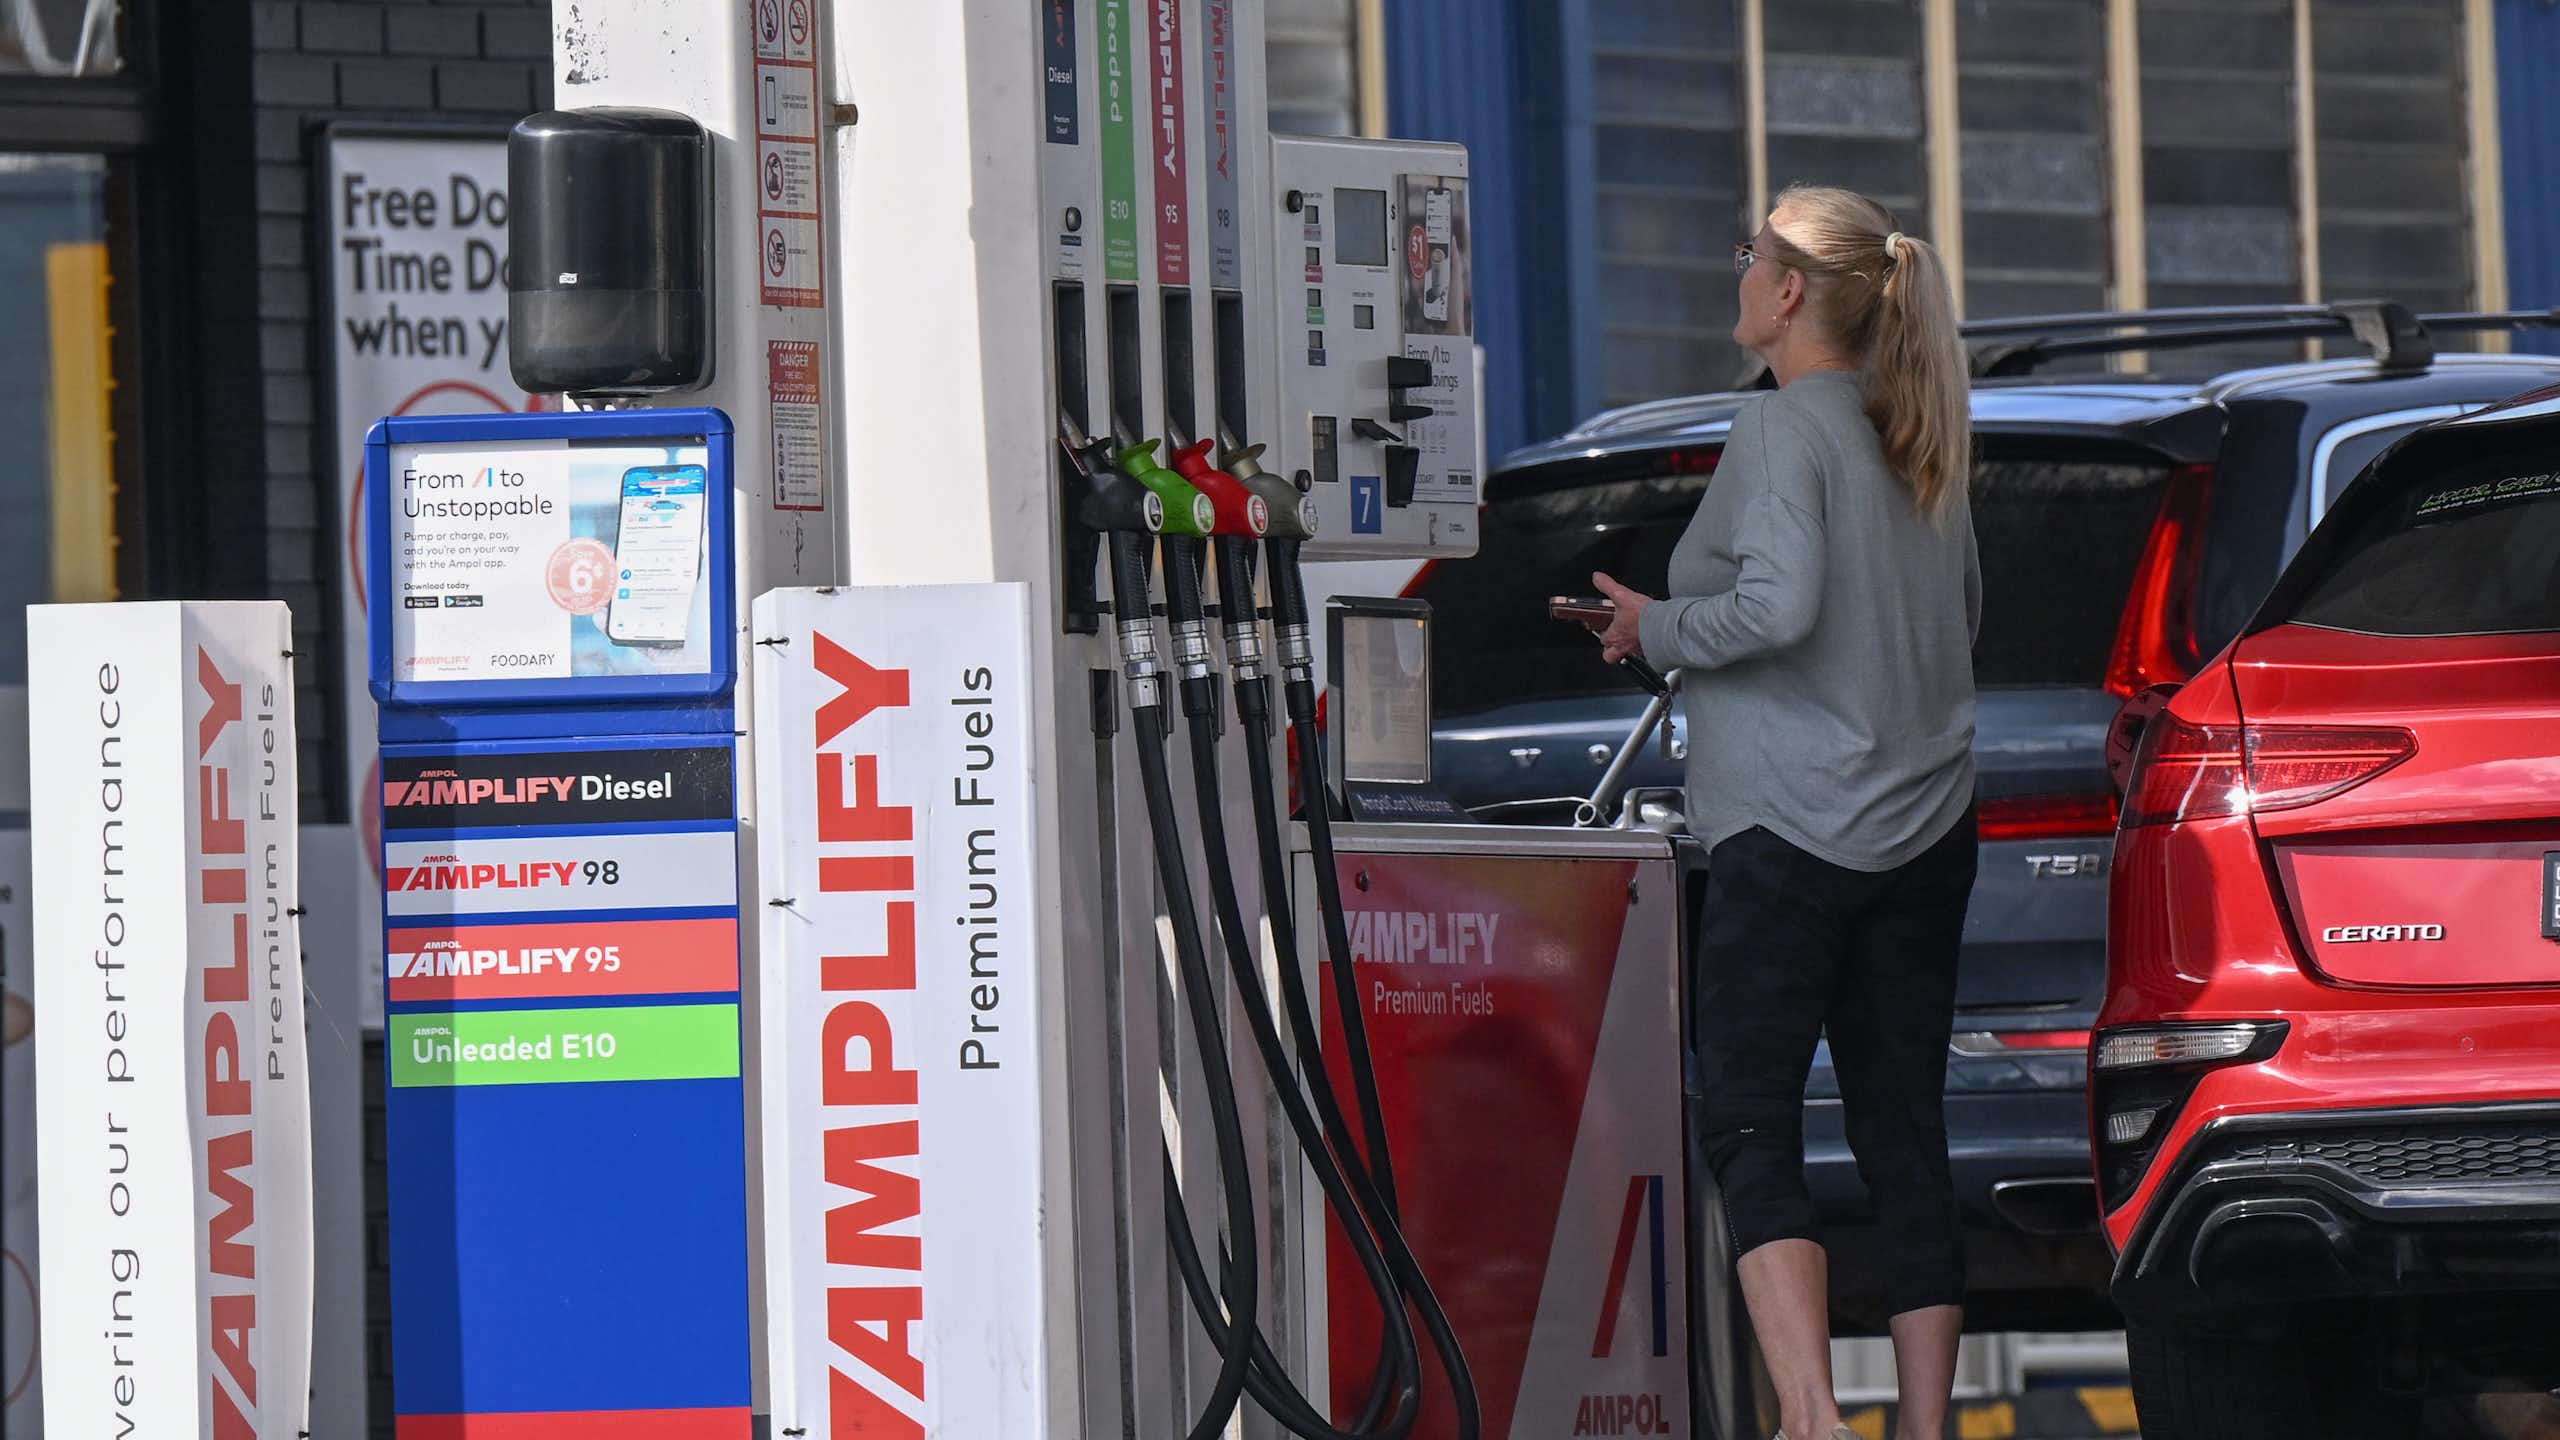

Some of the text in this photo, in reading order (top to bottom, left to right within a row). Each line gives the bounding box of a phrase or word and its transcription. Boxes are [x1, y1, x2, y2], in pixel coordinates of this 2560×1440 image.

[1048, 66, 1073, 85] Diesel
[1157, 0, 1176, 178] MPLIFY
[343, 174, 438, 227] Free
[1111, 200, 1128, 219] E10
[1165, 204, 1178, 224] 95
[1217, 208, 1230, 228] 98
[343, 239, 451, 292] Time
[347, 303, 467, 357] when
[779, 353, 809, 367] DANGER
[1441, 349, 1450, 364] to
[404, 470, 464, 489] From
[500, 469, 524, 487] to
[404, 494, 552, 521] Unstoppable
[1359, 487, 1372, 524] 7
[404, 532, 433, 543] Pump
[450, 531, 487, 542] charge,
[489, 531, 509, 542] pay,
[404, 545, 520, 556] and you're on your way
[404, 558, 507, 571] with the Ampol app.
[404, 583, 470, 591] Download today
[491, 654, 555, 666] FOODARY
[419, 770, 458, 778] AMPOL
[403, 771, 673, 806] AMPLIFY Diesel
[95, 662, 136, 1083] performance
[421, 855, 461, 864] AMPOL
[951, 665, 1001, 1071] Premium Fuels
[257, 682, 285, 1082] Premium Fuels
[405, 860, 620, 891] AMPLIFY 98
[423, 941, 462, 950] AMPOL
[1352, 910, 1499, 965] AMPLIFY
[2323, 924, 2446, 943] CERATO
[408, 946, 621, 977] AMPLIFY 95
[1375, 981, 1494, 1016] Premium Fuels
[198, 644, 258, 1410] AMPLIFY
[813, 630, 925, 1402] AMPLIFY
[414, 1028, 452, 1036] AMPOL
[413, 1033, 616, 1063] Unleaded E10
[109, 1112, 132, 1217] our
[1573, 1394, 1670, 1436] AMPOL
